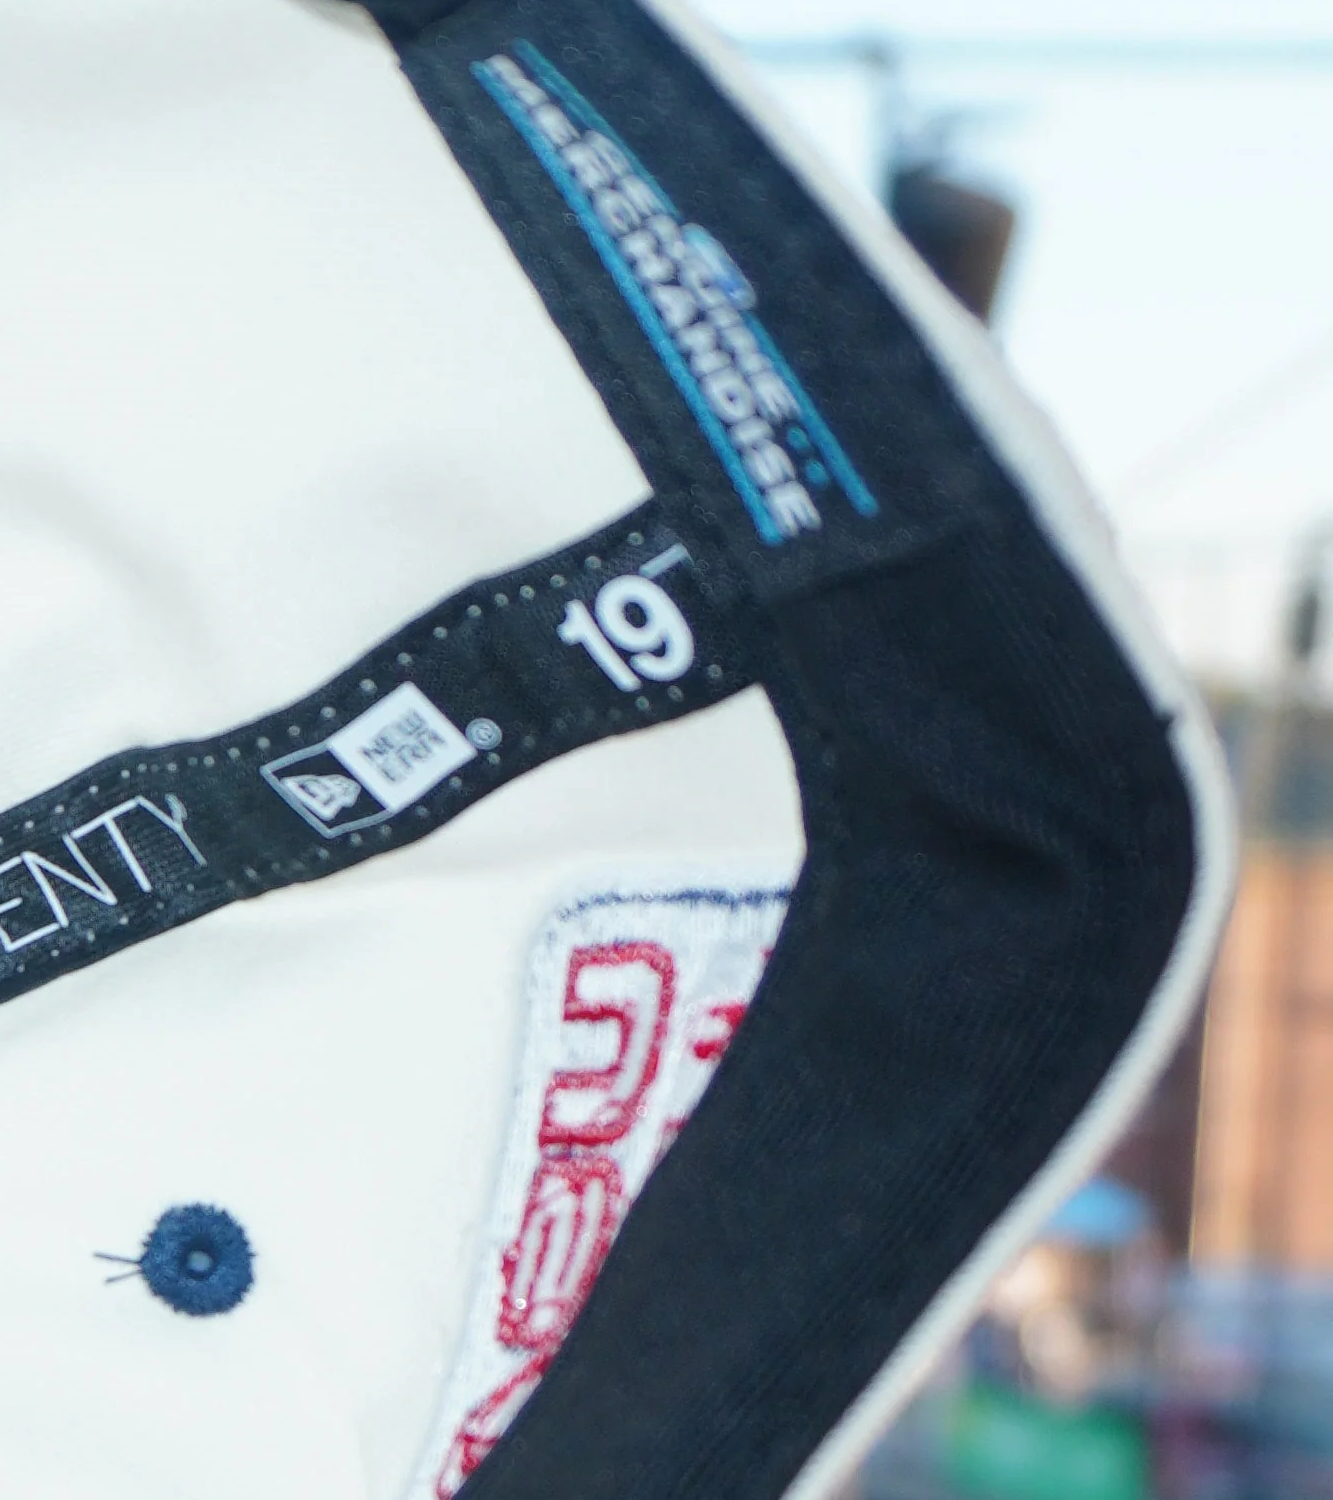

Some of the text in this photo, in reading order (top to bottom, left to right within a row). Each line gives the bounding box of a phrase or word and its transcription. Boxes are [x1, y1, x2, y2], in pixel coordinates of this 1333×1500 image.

[484, 55, 820, 534] MERCHANDISE
[586, 132, 800, 417] GENUINE
[361, 708, 428, 765] NEW
[379, 726, 446, 784] ERA
